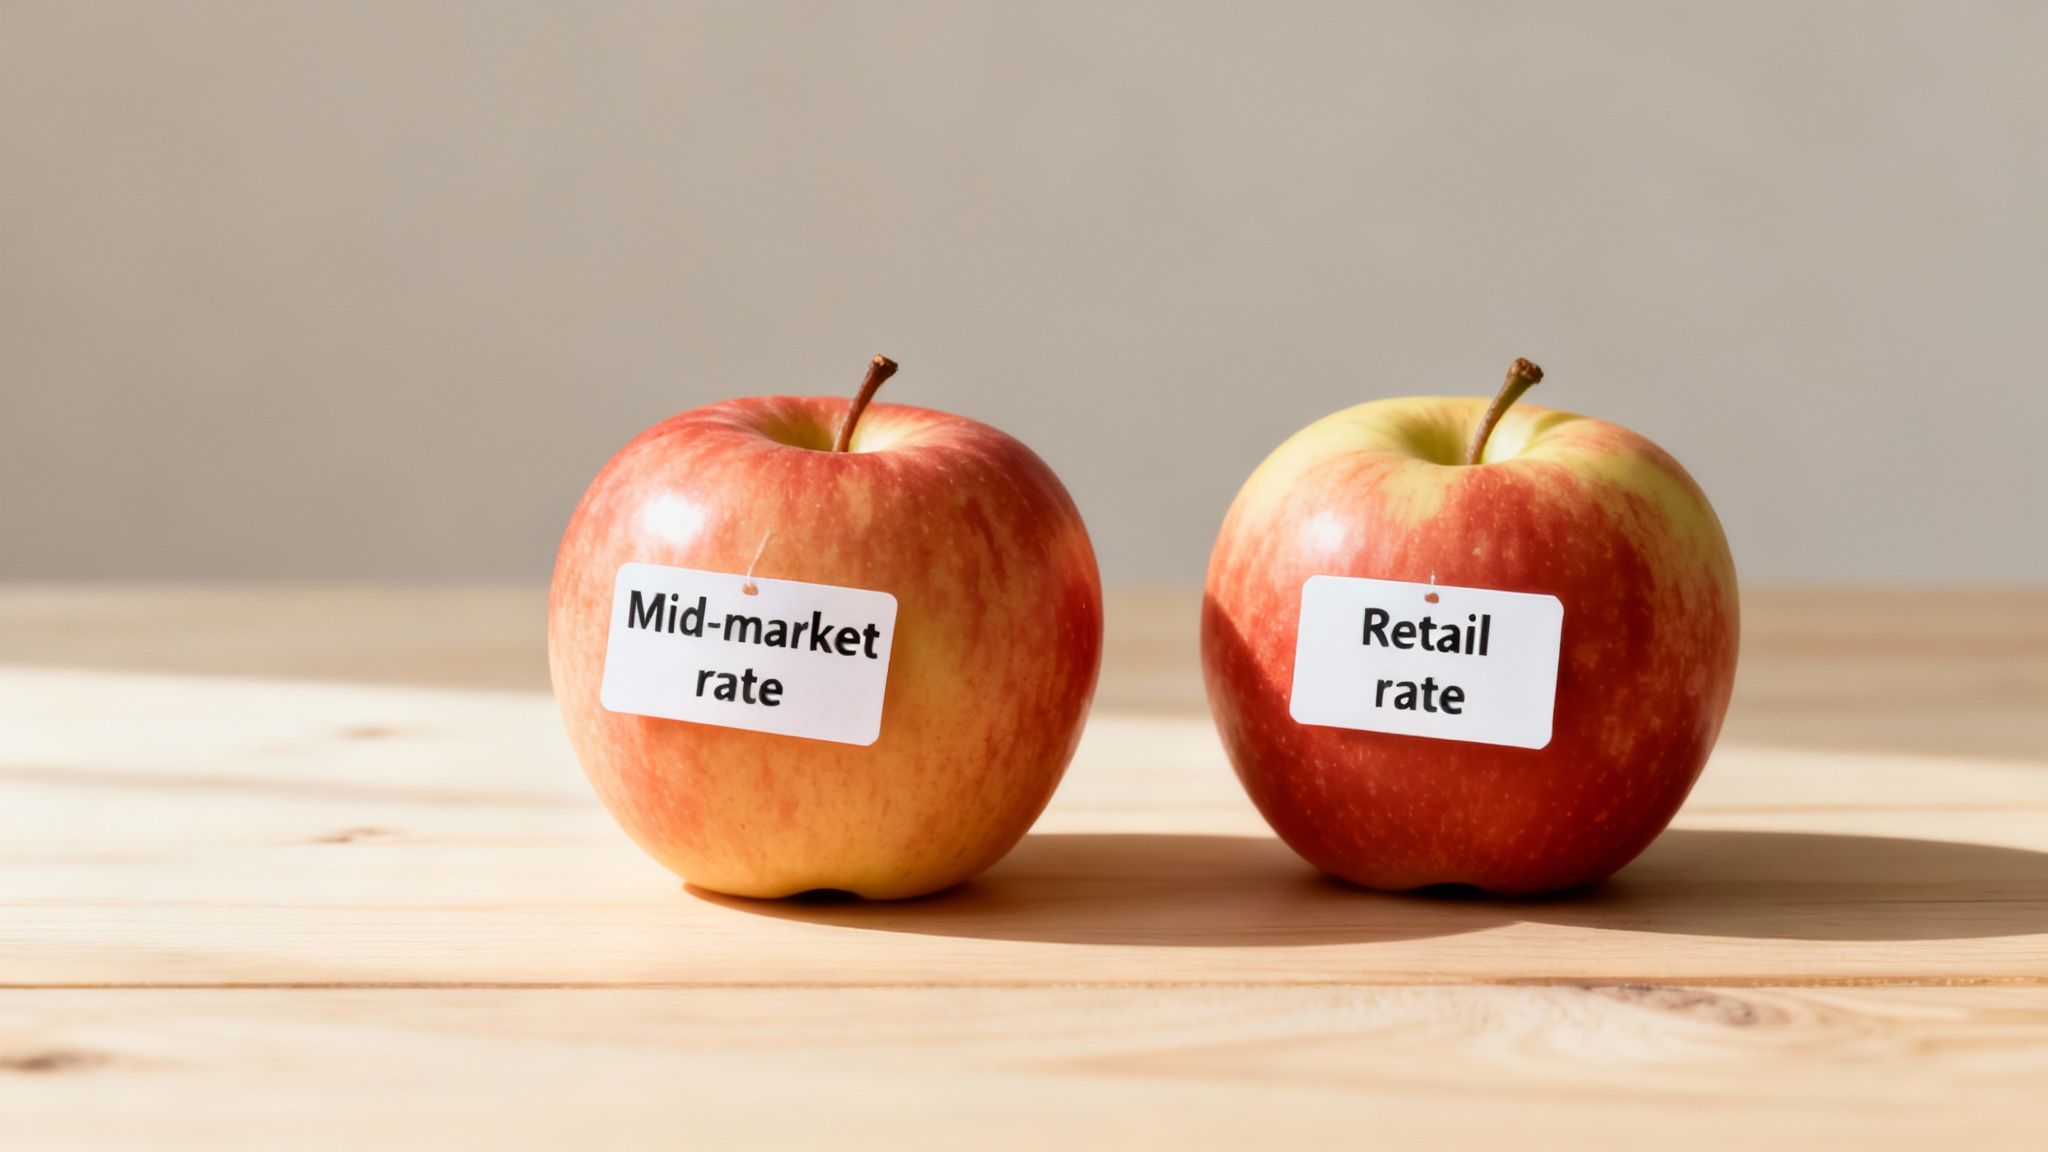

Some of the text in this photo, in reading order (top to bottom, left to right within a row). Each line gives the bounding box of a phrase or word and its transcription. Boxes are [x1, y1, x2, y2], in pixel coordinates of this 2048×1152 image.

[627, 590, 881, 660] Mid-market
[1362, 607, 1491, 657] Retail
[695, 668, 784, 707] rate
[1375, 676, 1465, 715] rate
